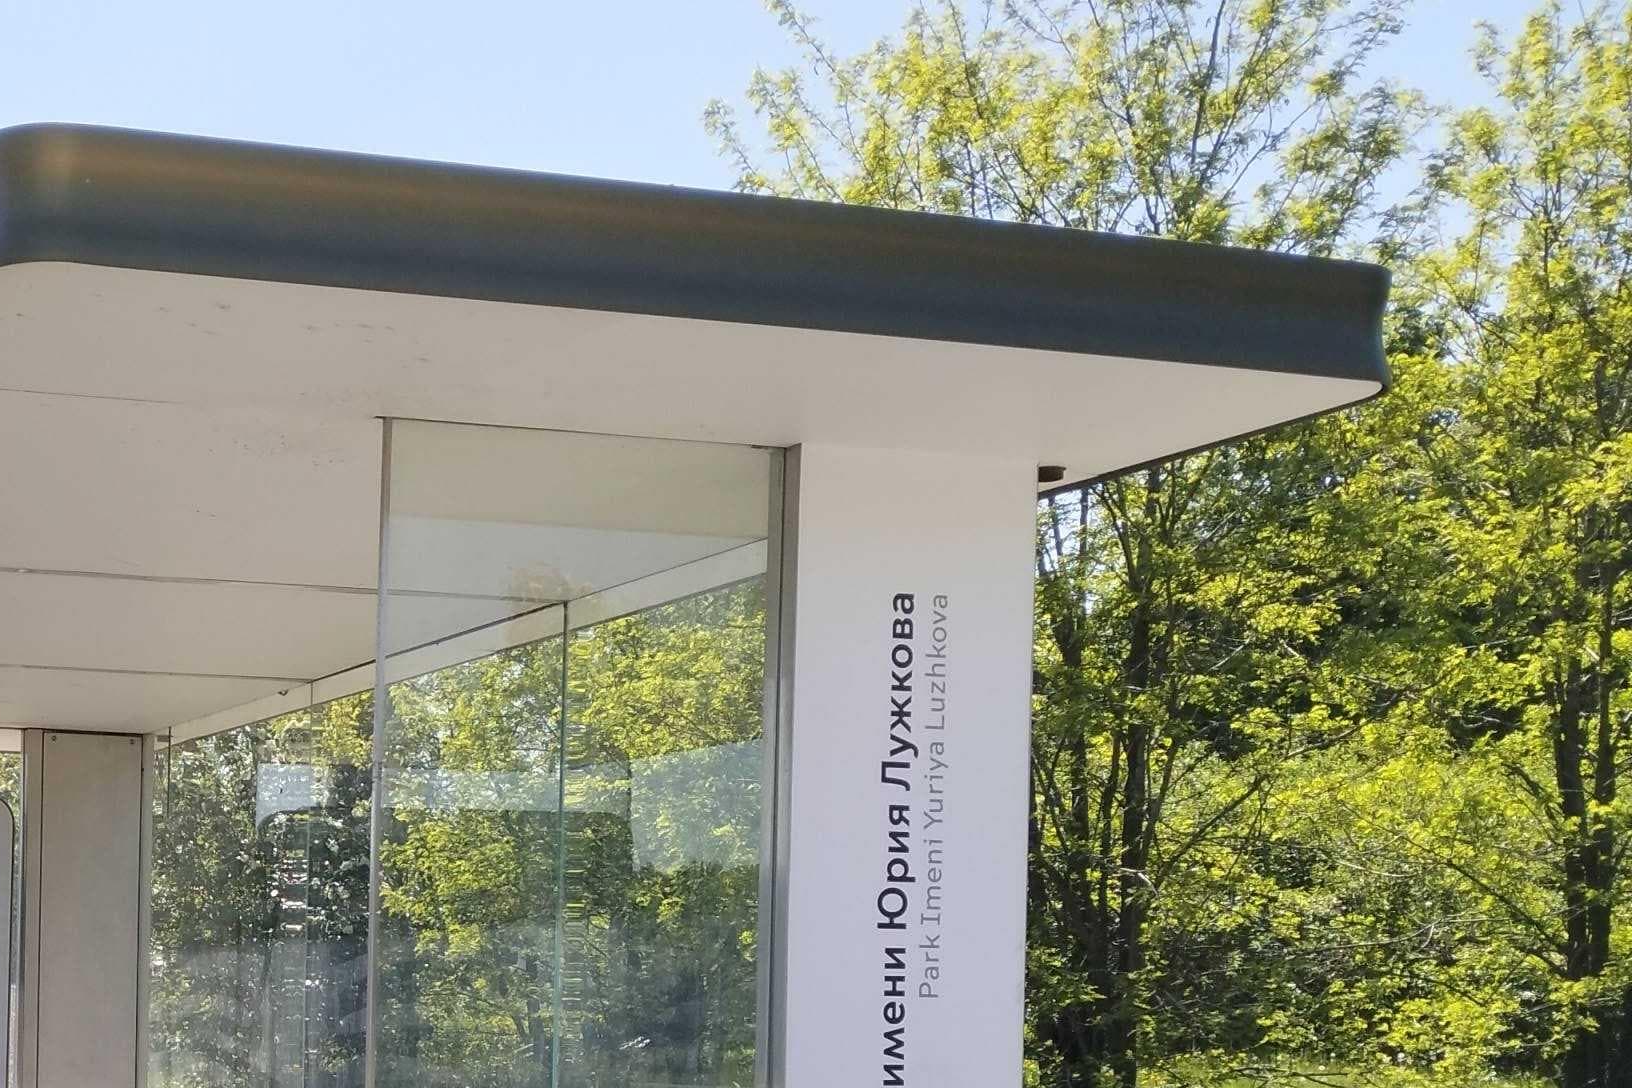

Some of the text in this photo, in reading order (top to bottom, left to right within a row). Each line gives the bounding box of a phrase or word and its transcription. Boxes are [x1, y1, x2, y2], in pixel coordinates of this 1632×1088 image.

[881, 593, 918, 791] Лужкова
[876, 804, 915, 930] Юрия
[919, 594, 949, 999] Park Imeni Yuriya Luzhkova
[882, 947, 906, 1086] имени
